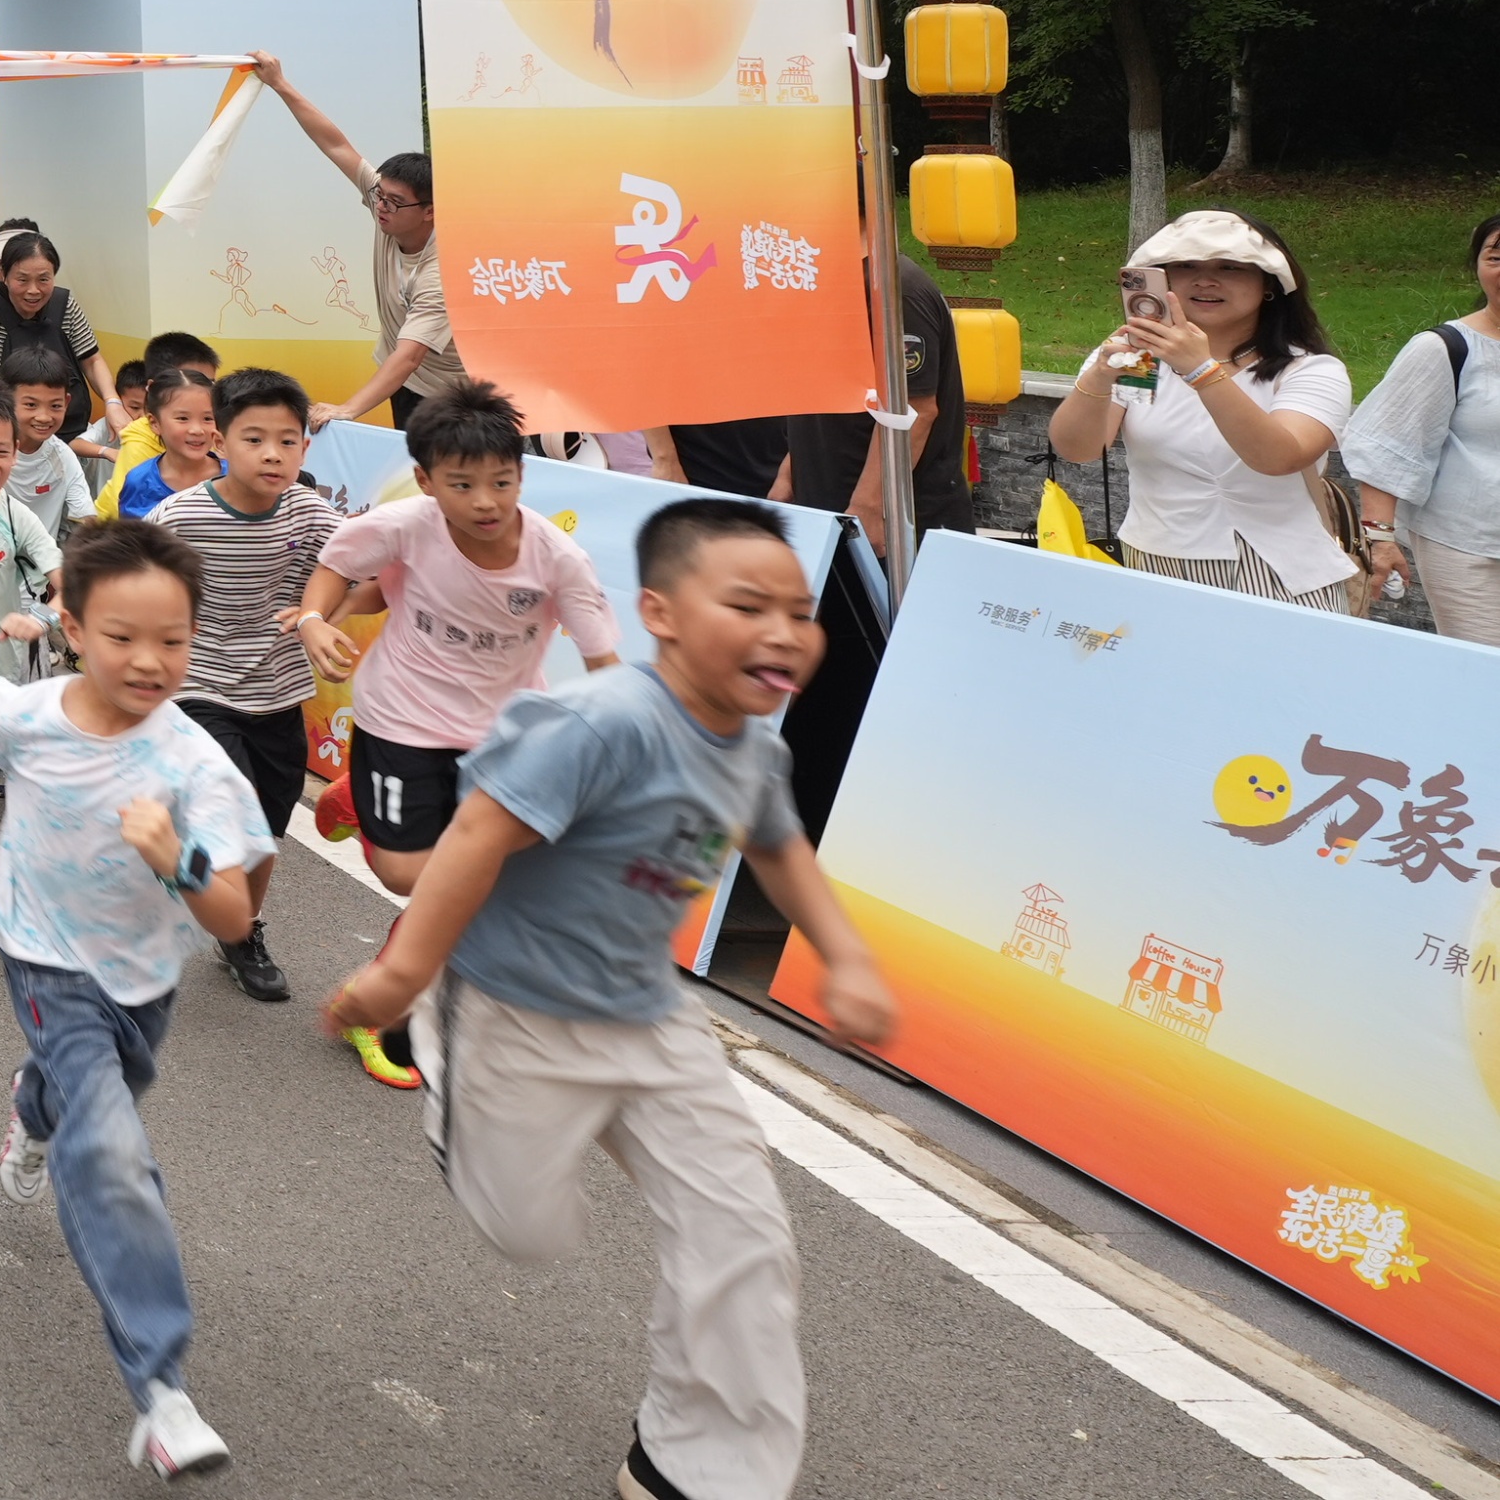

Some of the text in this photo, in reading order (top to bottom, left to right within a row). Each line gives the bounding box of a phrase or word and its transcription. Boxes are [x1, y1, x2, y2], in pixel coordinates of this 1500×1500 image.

[978, 601, 1033, 627] 万象服务
[1054, 621, 1123, 651] 美好常在
[371, 770, 403, 826] 11
[1182, 957, 1212, 978] House
[1415, 933, 1499, 986] 万象小
